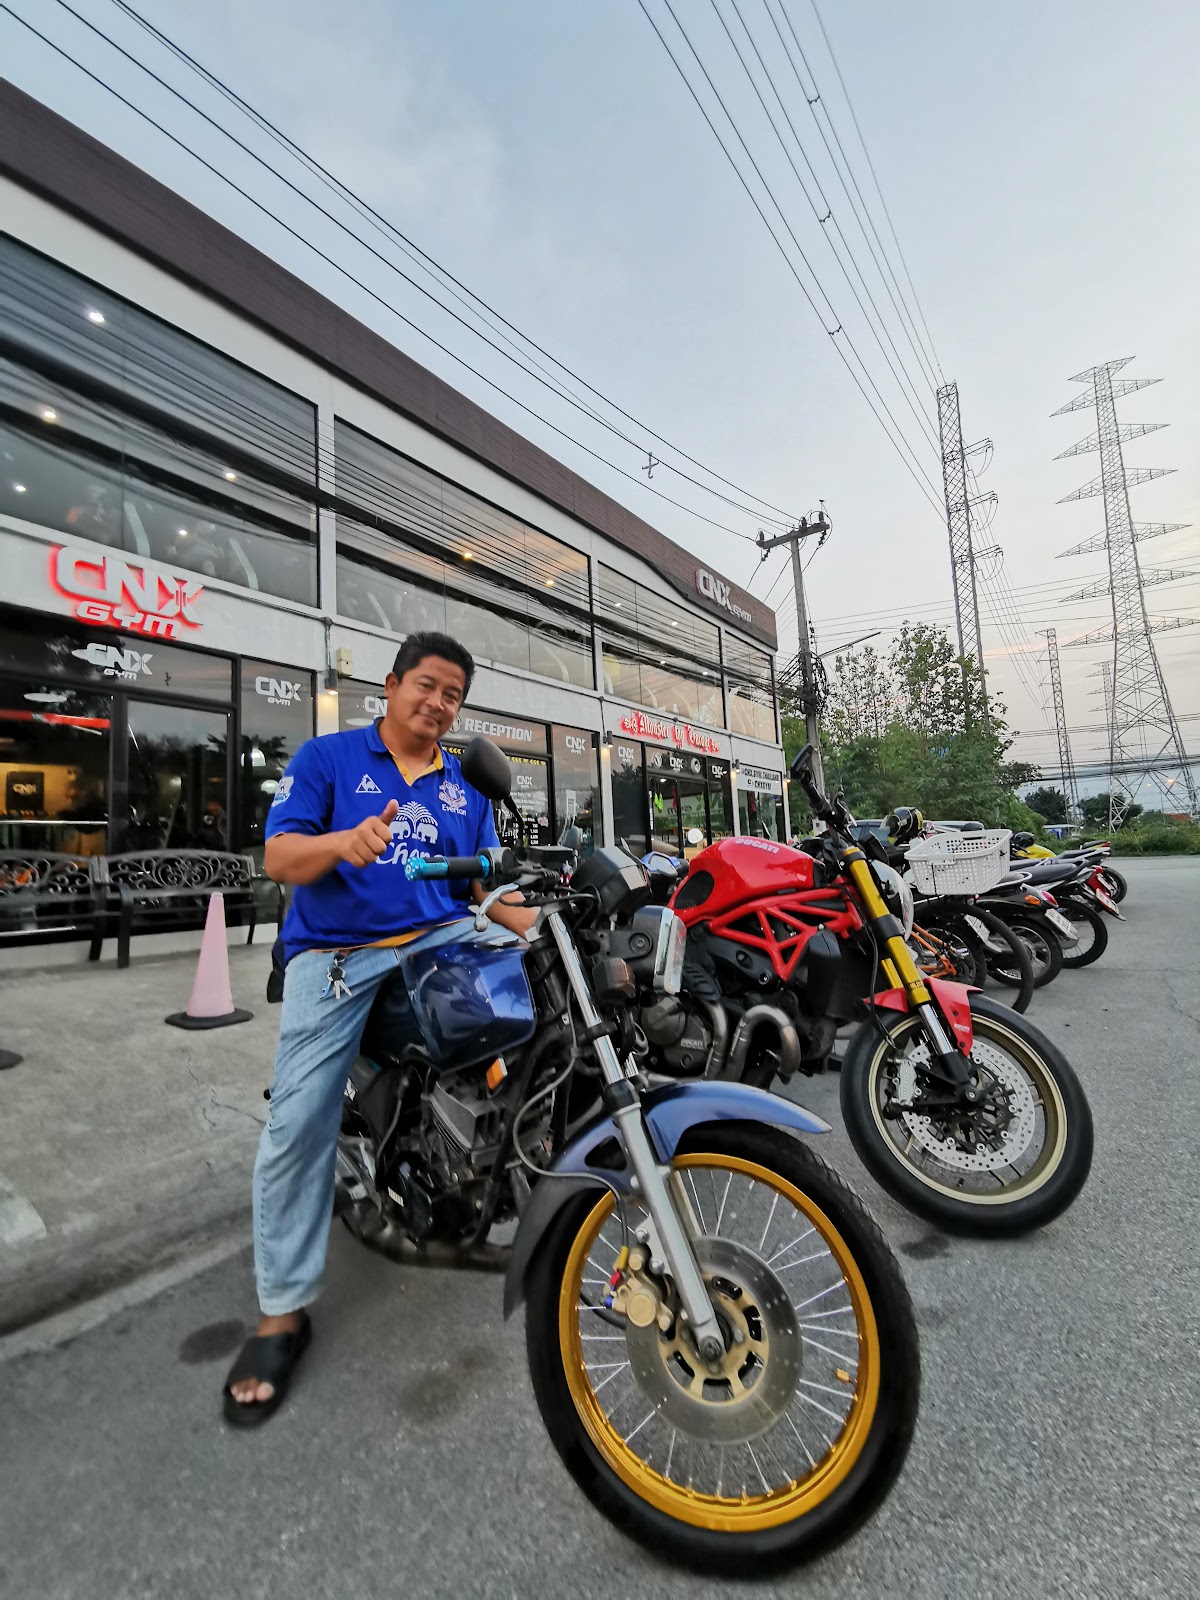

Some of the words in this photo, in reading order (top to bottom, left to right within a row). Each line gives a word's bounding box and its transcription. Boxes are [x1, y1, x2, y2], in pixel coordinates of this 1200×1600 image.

[55, 546, 204, 626] CNX
[696, 568, 732, 612] CNX
[76, 600, 182, 639] GYM
[86, 642, 153, 675] CNX
[104, 668, 138, 681] GYM
[255, 676, 302, 702] CNX
[267, 697, 291, 707] GYM
[363, 696, 388, 717] CN
[464, 717, 533, 742] RECEPTION
[565, 735, 586, 751] CNX
[617, 745, 635, 760] CNX
[516, 776, 533, 786] CNX
[441, 803, 467, 817] Everton
[734, 838, 780, 854] DUCATI
